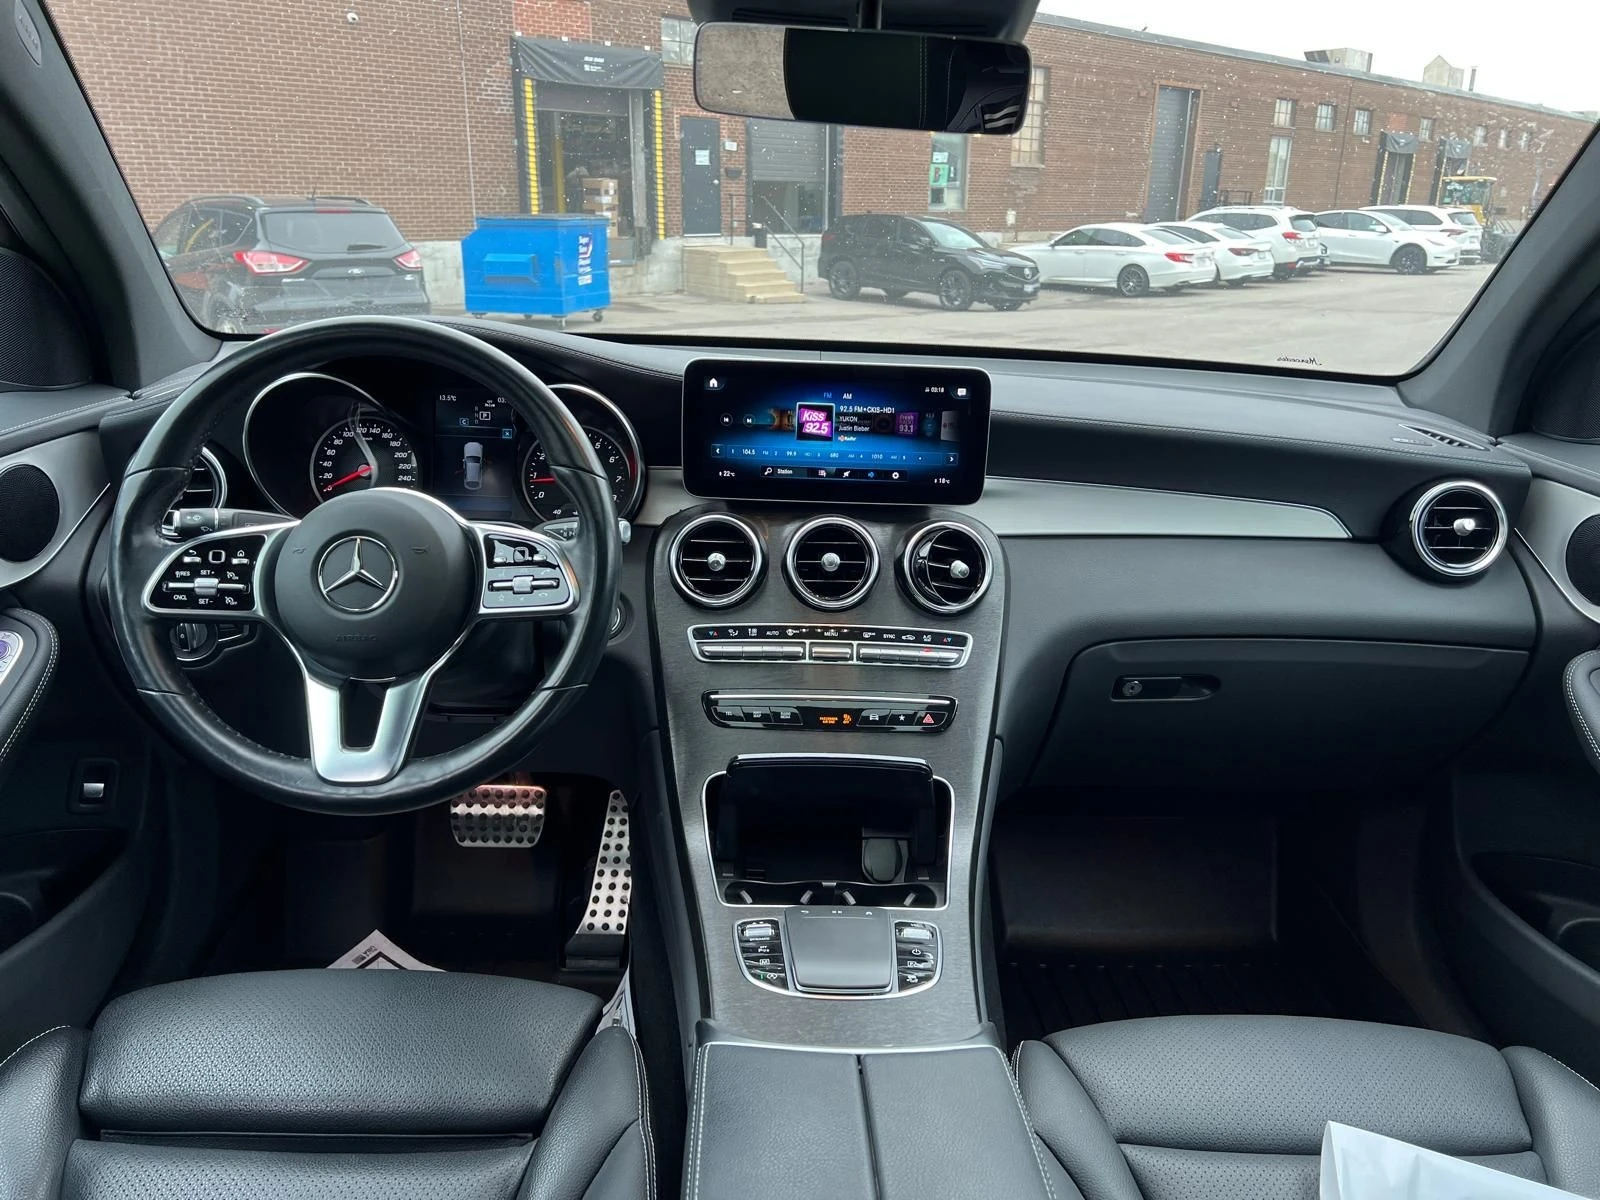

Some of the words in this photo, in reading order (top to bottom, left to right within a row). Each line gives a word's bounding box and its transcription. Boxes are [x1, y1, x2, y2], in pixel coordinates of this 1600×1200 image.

[839, 405, 853, 413] 92.5
[805, 422, 829, 434] 92.5
[899, 424, 914, 433] 93.1
